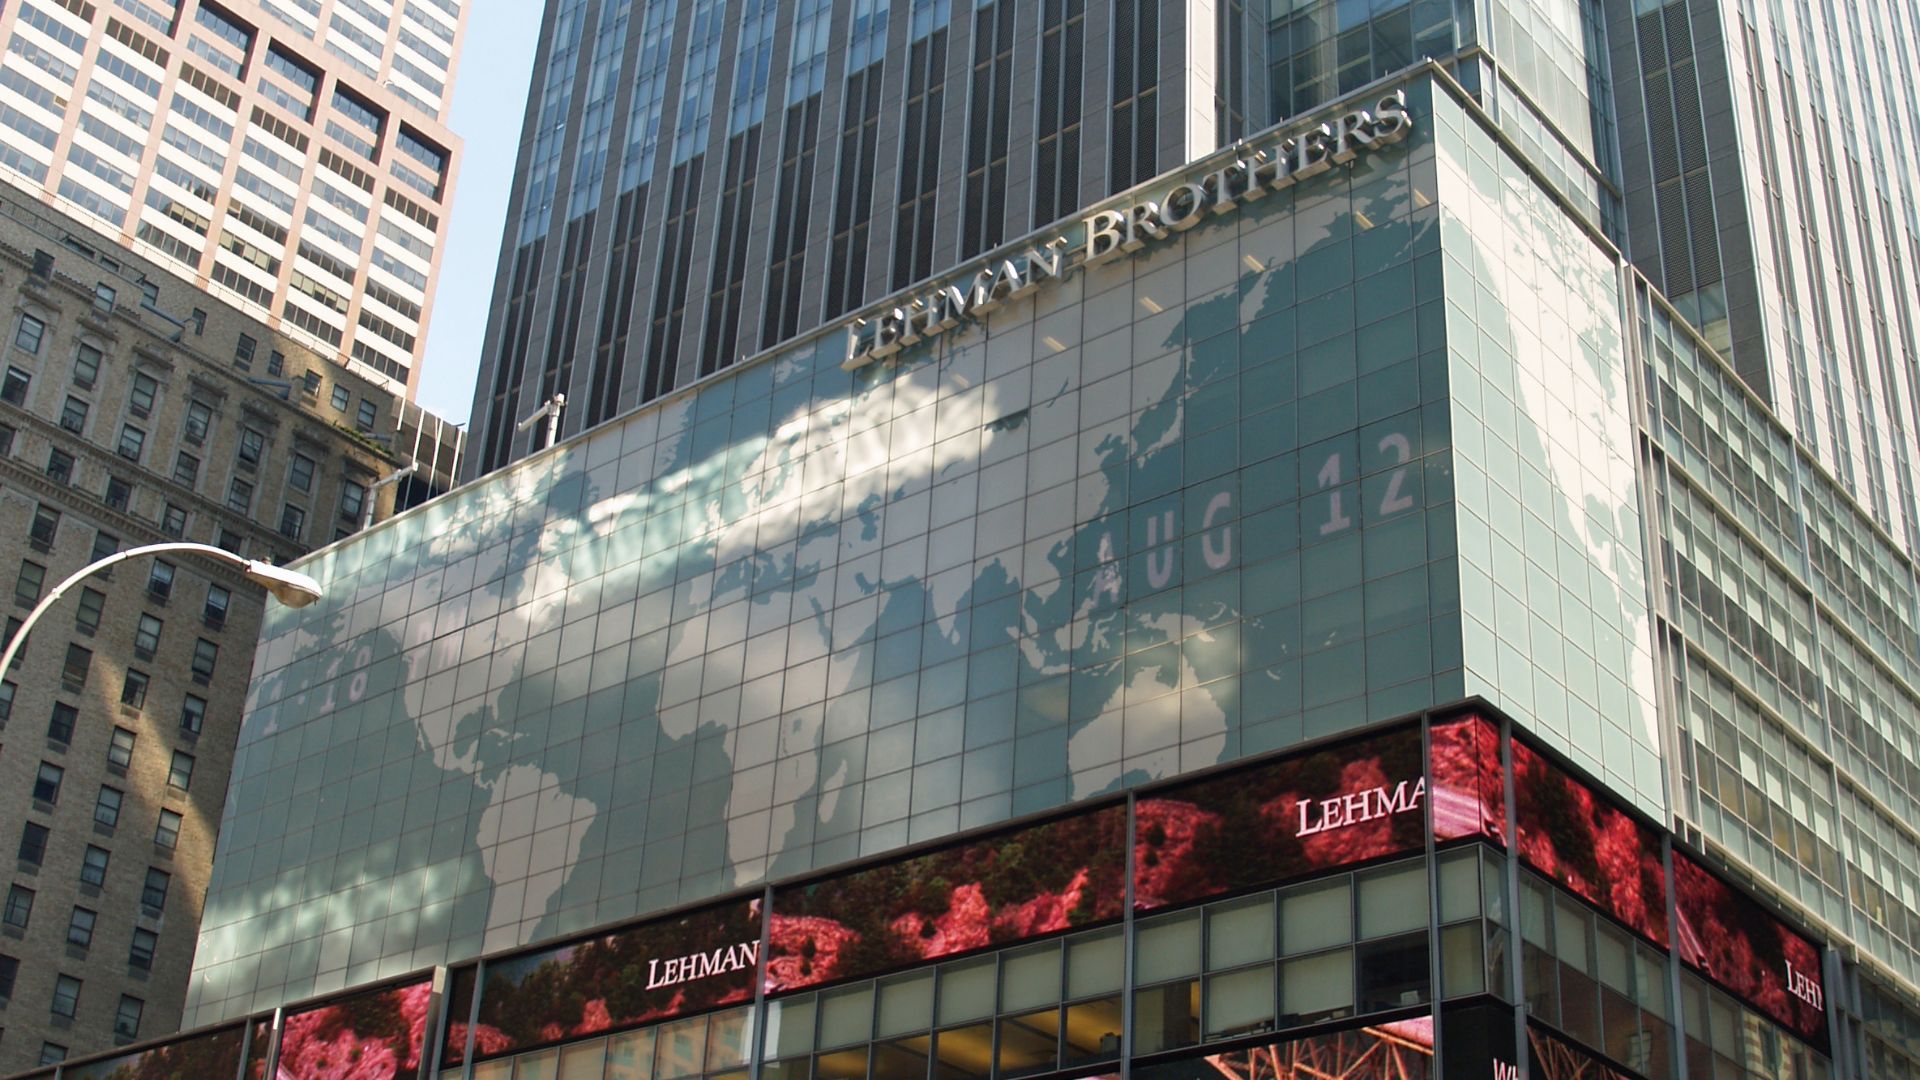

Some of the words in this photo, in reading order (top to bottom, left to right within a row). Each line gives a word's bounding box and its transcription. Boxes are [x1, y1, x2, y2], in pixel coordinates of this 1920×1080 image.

[841, 235, 1068, 371] LEHMAN
[1081, 89, 1413, 267] BROTHERS
[1092, 491, 1232, 606] AUG
[1317, 432, 1414, 535] 12
[645, 940, 762, 990] LEHMAN
